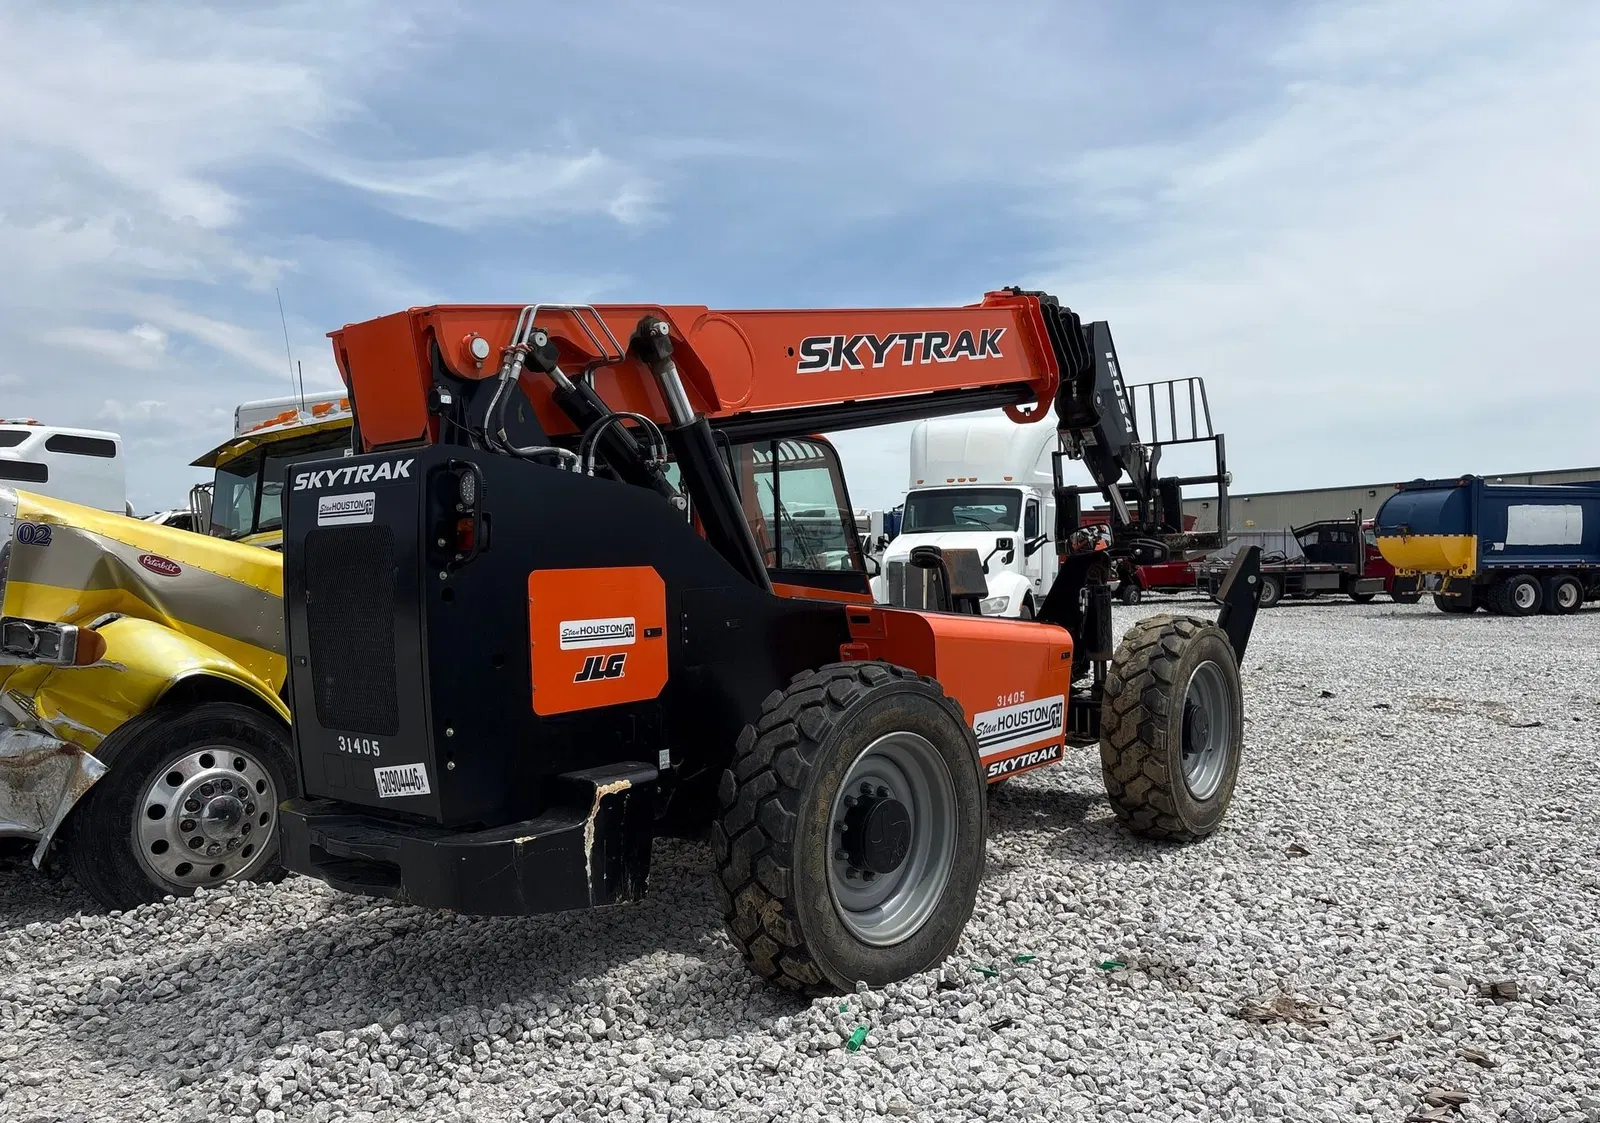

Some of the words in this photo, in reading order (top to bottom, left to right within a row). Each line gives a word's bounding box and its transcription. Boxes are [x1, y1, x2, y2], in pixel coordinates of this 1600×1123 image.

[797, 328, 1007, 374] SKYTRAK
[1105, 352, 1133, 433] 12054
[293, 458, 415, 491] SKYTRAK
[16, 522, 52, 547] 02
[143, 555, 177, 573] Peterbilt
[573, 652, 627, 684] JLG
[996, 690, 1026, 707] 31405
[338, 735, 381, 757] 31405
[987, 745, 1059, 778] SKYTRAK
